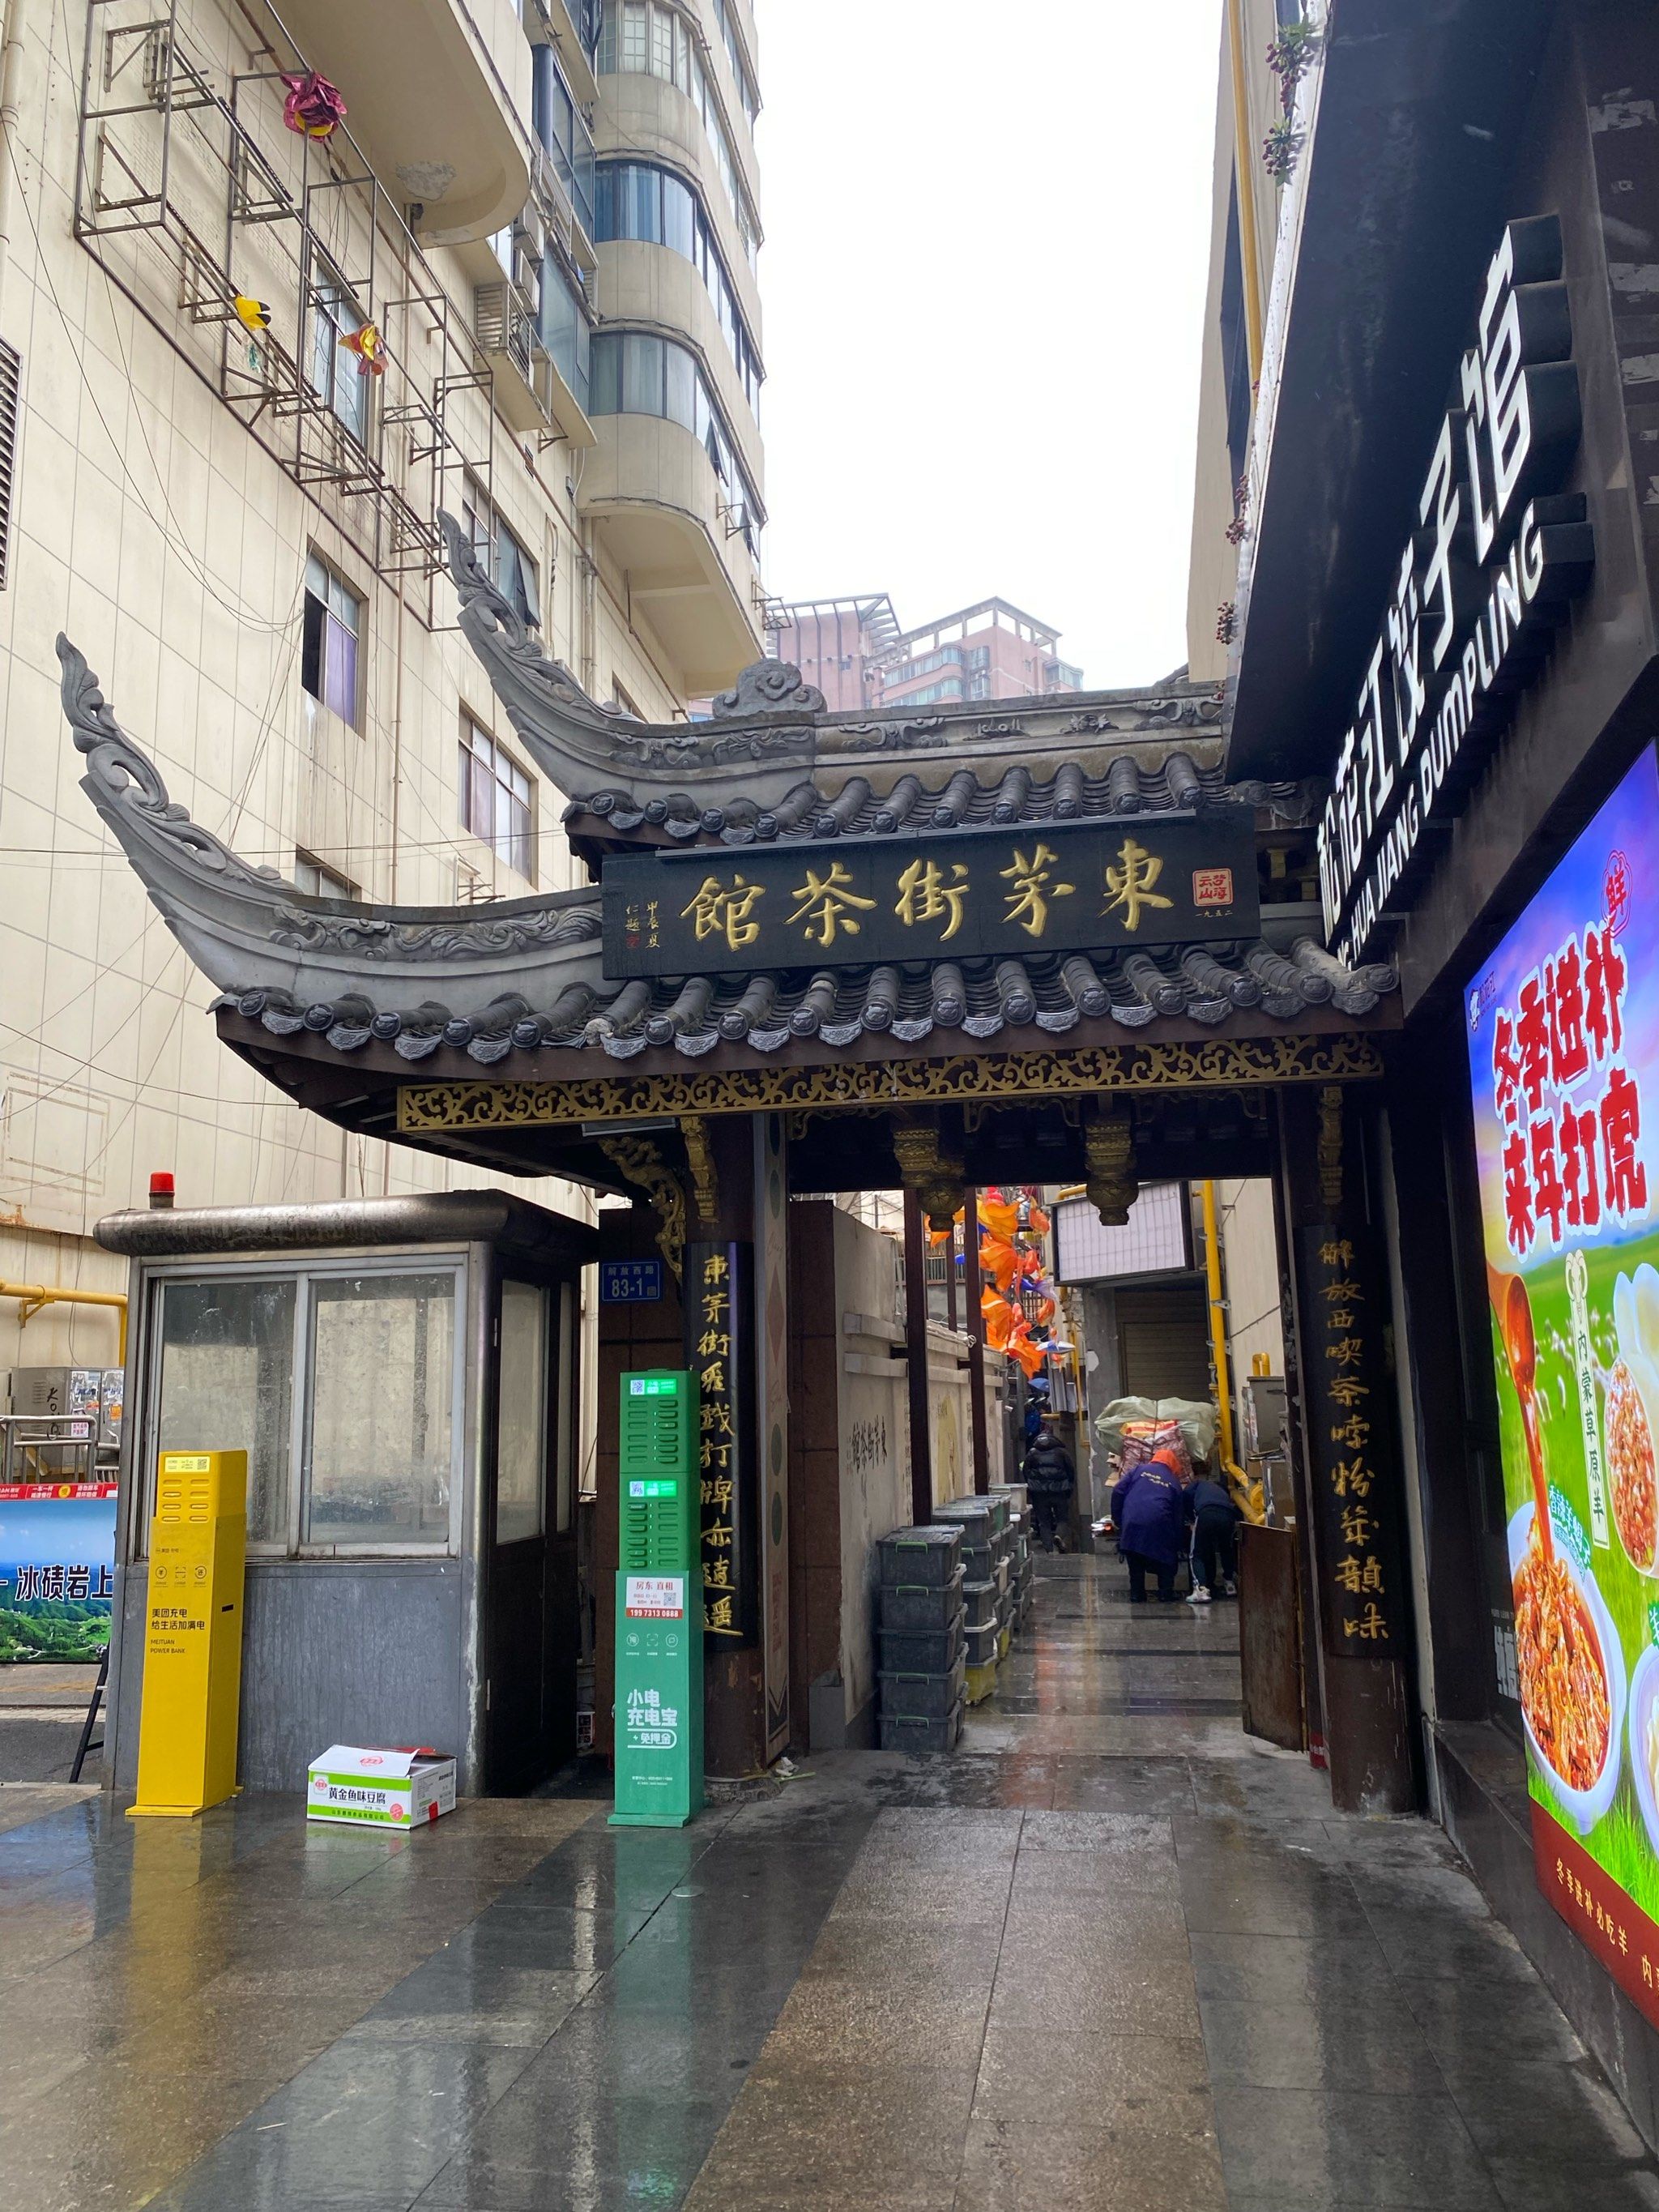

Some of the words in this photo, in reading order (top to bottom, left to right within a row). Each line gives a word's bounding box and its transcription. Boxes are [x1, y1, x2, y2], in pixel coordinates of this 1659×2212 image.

[1317, 225, 1530, 948] 松花江饺子馆
[1351, 878, 1375, 963] HUA
[1377, 783, 1418, 912] JIANG
[1420, 497, 1543, 817] DUMPLING
[1503, 1067, 1645, 1256] 来年打虎
[612, 1278, 642, 1297] 83-1
[1577, 1331, 1605, 1524] 内蒙草原羊
[152, 1608, 187, 1617] 美团充电
[151, 1621, 205, 1629] 给生活加满电
[627, 1689, 660, 1707] 小电
[627, 1707, 678, 1727] 充电宝
[641, 1732, 672, 1744] 免押金
[329, 1787, 386, 1804] 黄金鱼味豆腐
